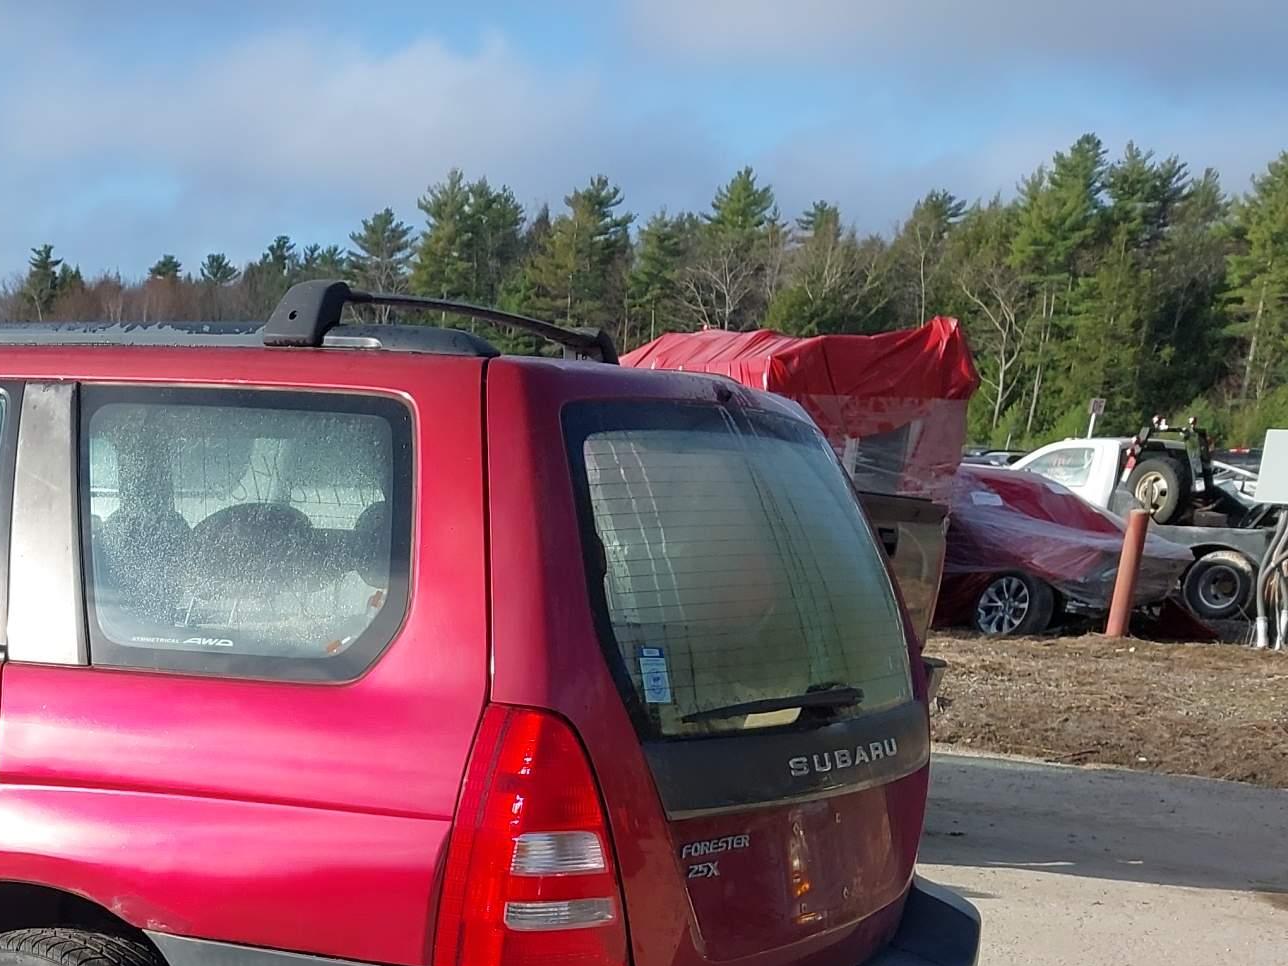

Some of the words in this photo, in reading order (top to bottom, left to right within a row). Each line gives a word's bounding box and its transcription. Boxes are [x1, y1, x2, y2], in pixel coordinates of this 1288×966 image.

[182, 637, 233, 647] AWD
[789, 738, 897, 777] SUBARU
[682, 834, 751, 859] FORESTER
